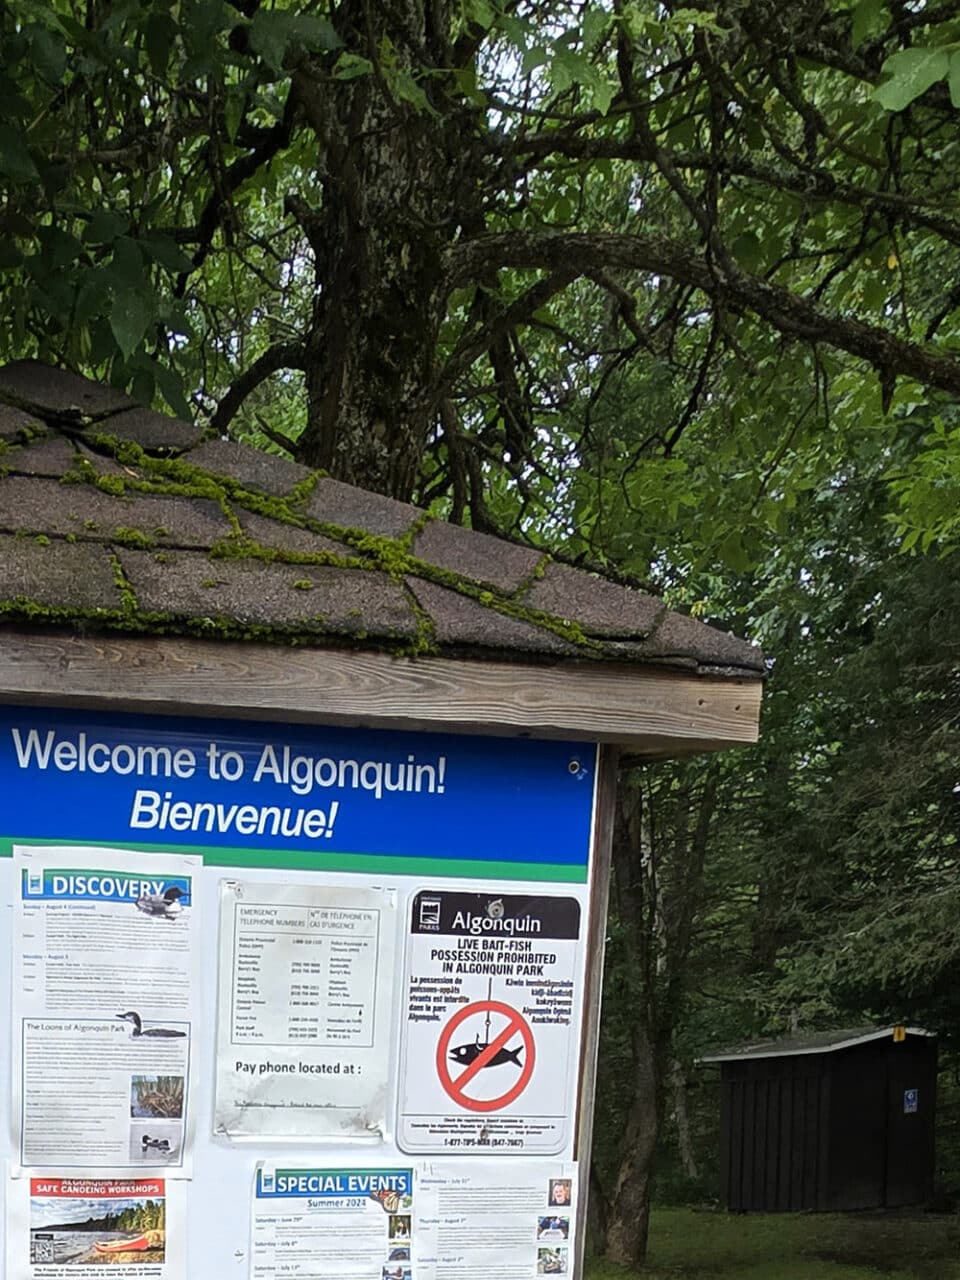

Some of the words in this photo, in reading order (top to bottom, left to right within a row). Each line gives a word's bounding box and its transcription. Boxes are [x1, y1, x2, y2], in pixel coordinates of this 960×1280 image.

[12, 728, 196, 779] Welcome
[206, 742, 243, 781] to
[254, 743, 446, 799] Algonquin!
[129, 790, 339, 839] Bienvenue!
[53, 876, 165, 898] DISCOVERY
[452, 911, 541, 935] Algonquin
[458, 938, 479, 950] LIVE
[482, 940, 532, 952] BAIT-FISH
[431, 950, 494, 962] POSSESSION
[497, 952, 556, 964] PROHIBITED
[442, 962, 453, 972] IN
[456, 963, 513, 976] ALGONQUIN
[516, 965, 544, 976] PARK
[64, 1024, 73, 1032] of
[74, 1024, 109, 1033] Algonquin
[111, 1025, 125, 1033] Park
[235, 1061, 257, 1075] Pay
[259, 1062, 296, 1075] phone
[299, 1062, 340, 1074] located
[343, 1064, 354, 1075] at
[37, 1185, 58, 1193] SAFE
[61, 1185, 106, 1194] CANOEING
[108, 1185, 160, 1194] WORKSHOPS
[278, 1176, 345, 1192] SPECIAL
[348, 1176, 407, 1191] EVENTS
[307, 1199, 343, 1208] Summer
[346, 1199, 367, 1207] 2024
